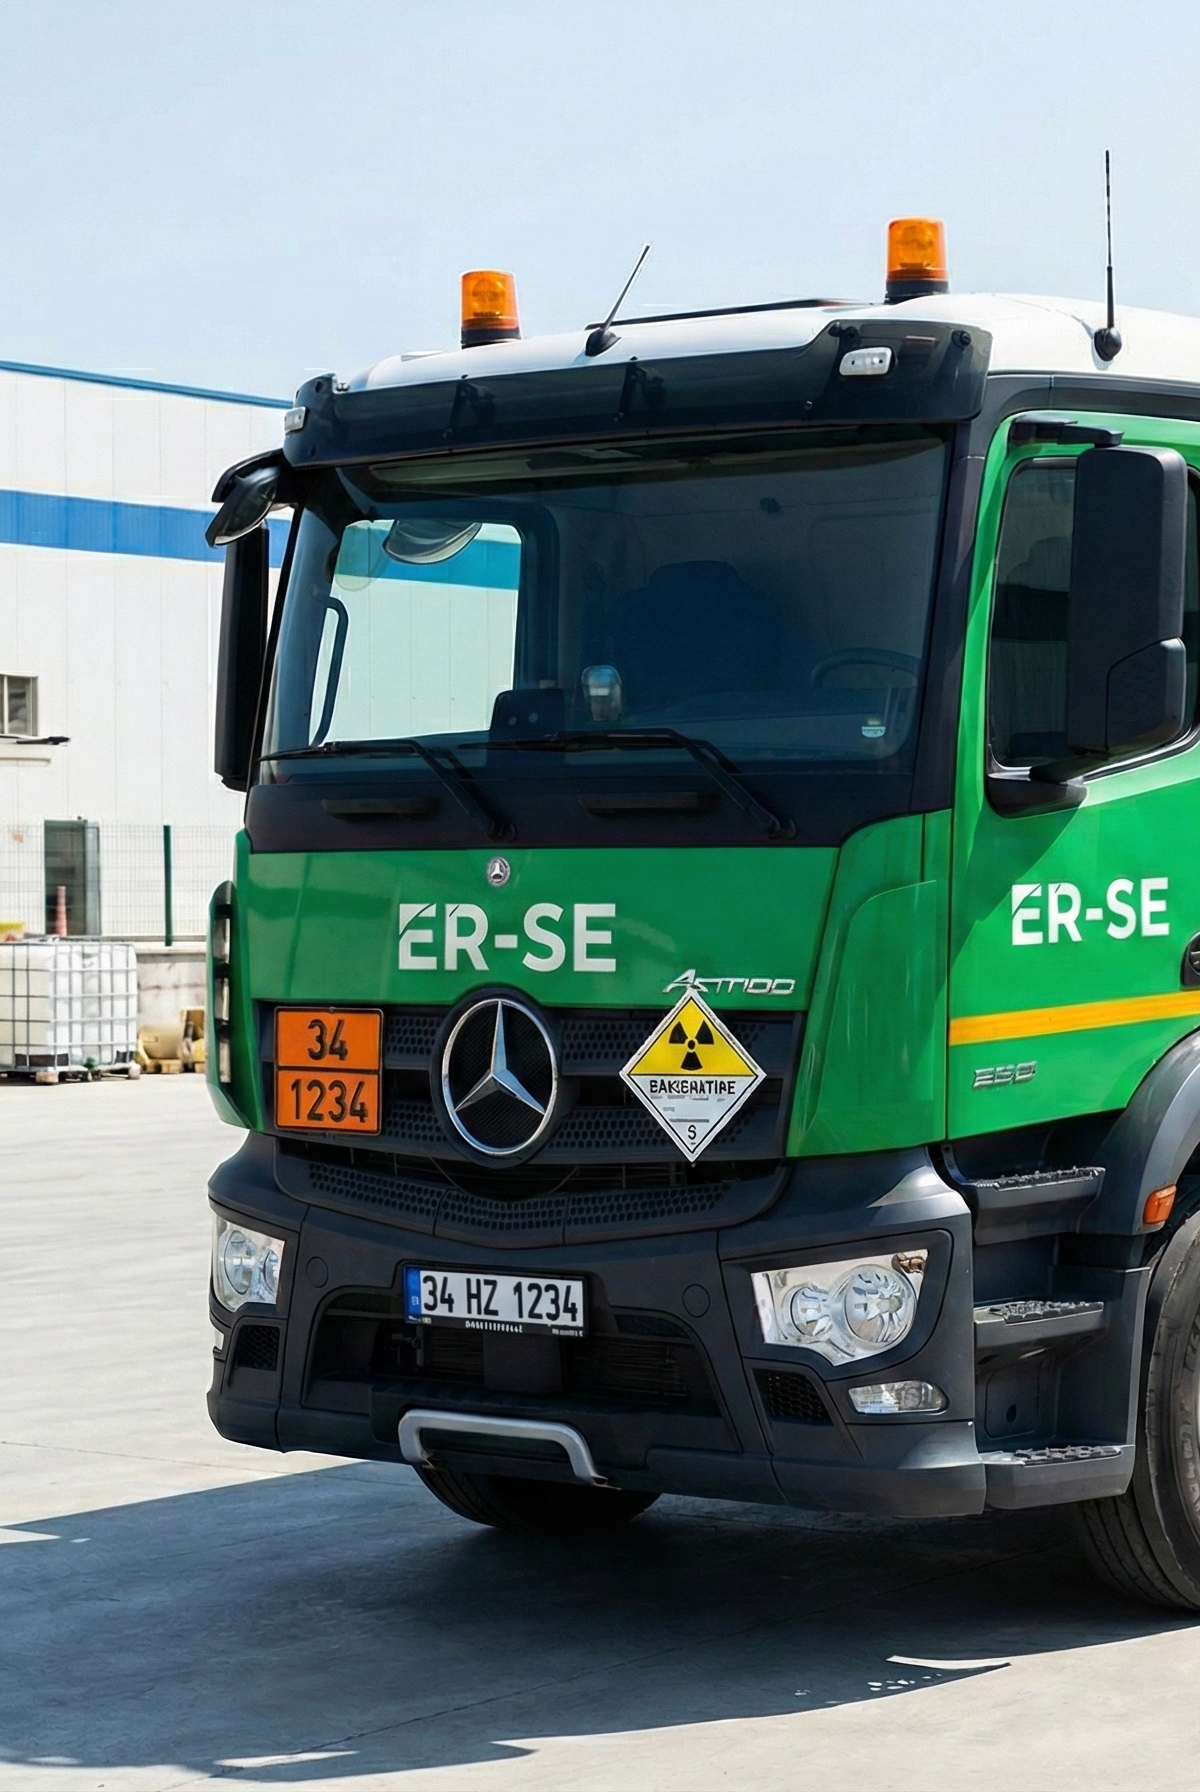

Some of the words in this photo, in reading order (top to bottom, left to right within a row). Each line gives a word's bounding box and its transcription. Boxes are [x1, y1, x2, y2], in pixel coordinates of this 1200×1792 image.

[1011, 876, 1170, 946] ER-SE
[398, 902, 617, 973] ER-SE
[307, 1018, 349, 1062] 34
[290, 1078, 369, 1123] 1234
[422, 1275, 455, 1313] 34
[466, 1277, 499, 1317] HZ
[513, 1281, 578, 1322] 1234
